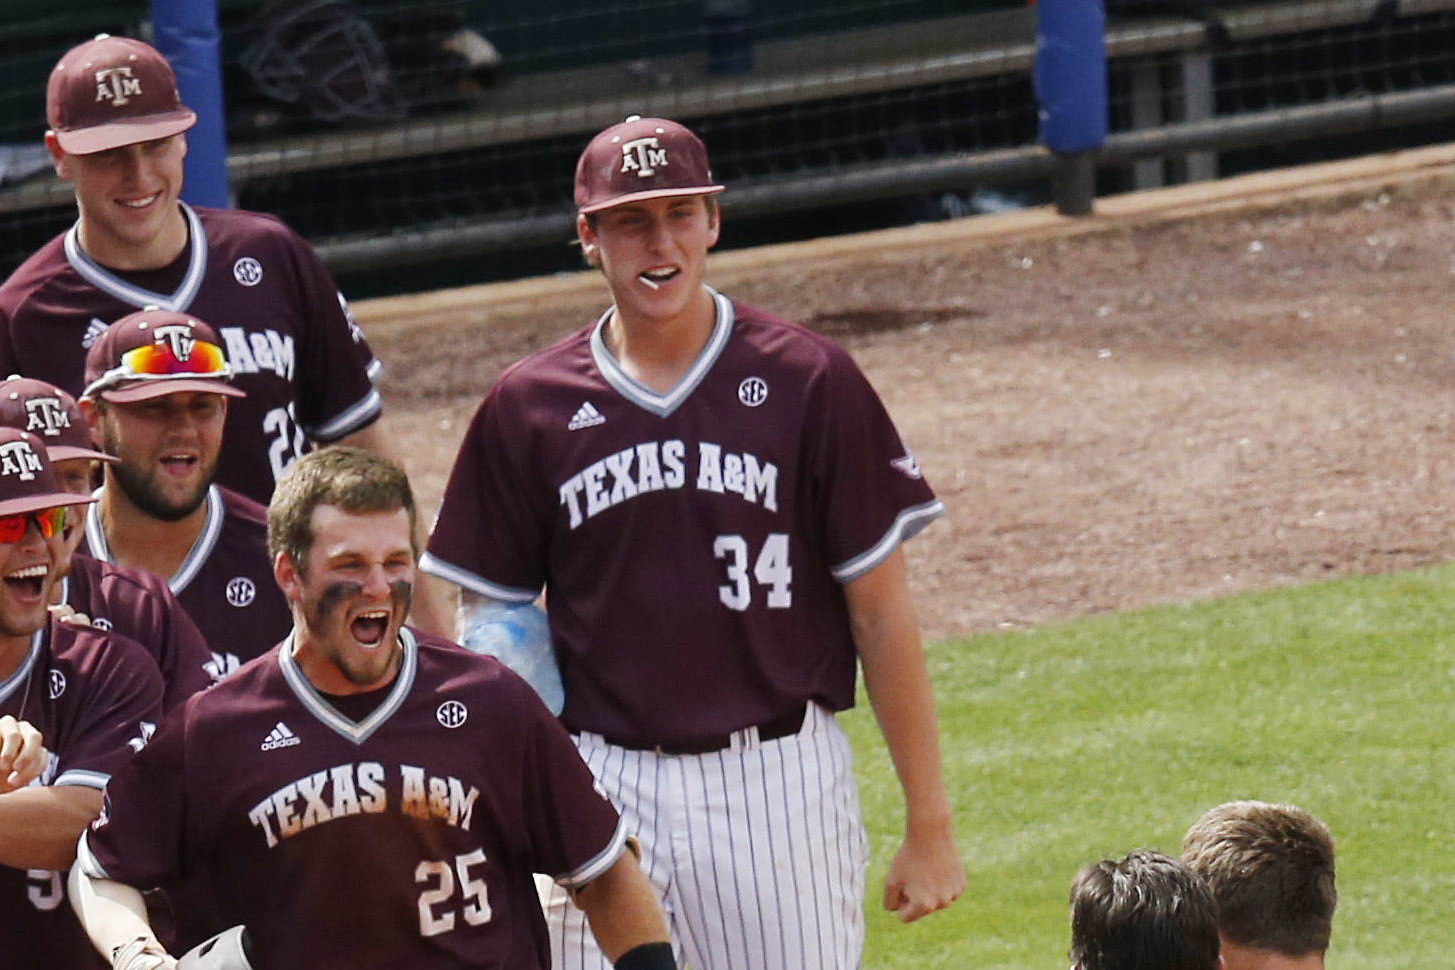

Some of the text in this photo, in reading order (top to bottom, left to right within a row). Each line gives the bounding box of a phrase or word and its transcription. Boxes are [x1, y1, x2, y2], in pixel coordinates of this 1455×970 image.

[739, 378, 768, 406] SEC
[560, 439, 779, 530] TEXAS A&M
[713, 532, 793, 612] 34
[435, 700, 468, 729] SEC
[248, 761, 481, 849] TEXAS A&M
[414, 847, 493, 938] 25
